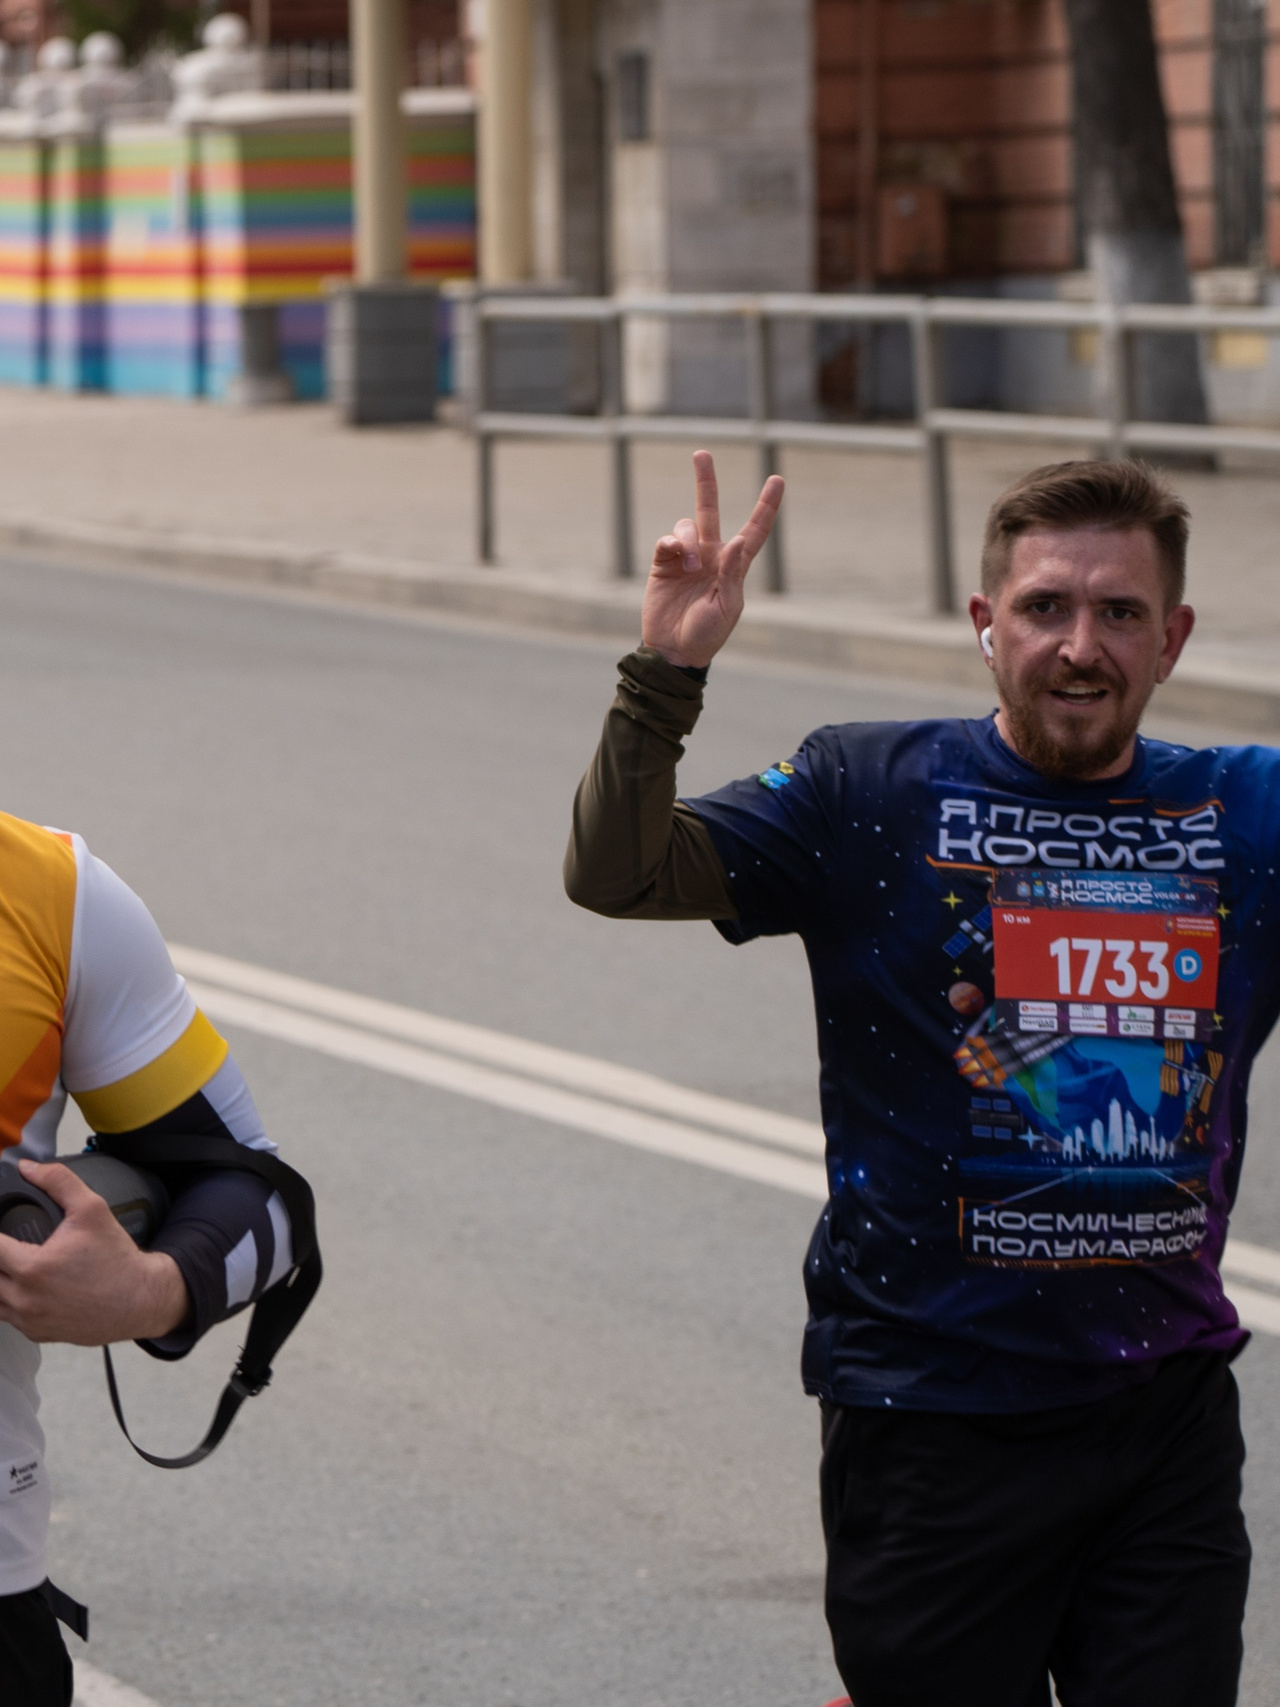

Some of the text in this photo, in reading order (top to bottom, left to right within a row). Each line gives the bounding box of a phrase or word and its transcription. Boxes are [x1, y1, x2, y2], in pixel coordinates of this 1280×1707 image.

[940, 798, 1218, 841] Я ПРОСТО
[938, 828, 1226, 870] КОСМОС
[1075, 880, 1153, 893] ПРОСТО
[1061, 890, 1154, 905] КОСМОС
[1002, 913, 1015, 924] 10
[1049, 937, 1171, 1000] 1733
[1181, 956, 1198, 975] D
